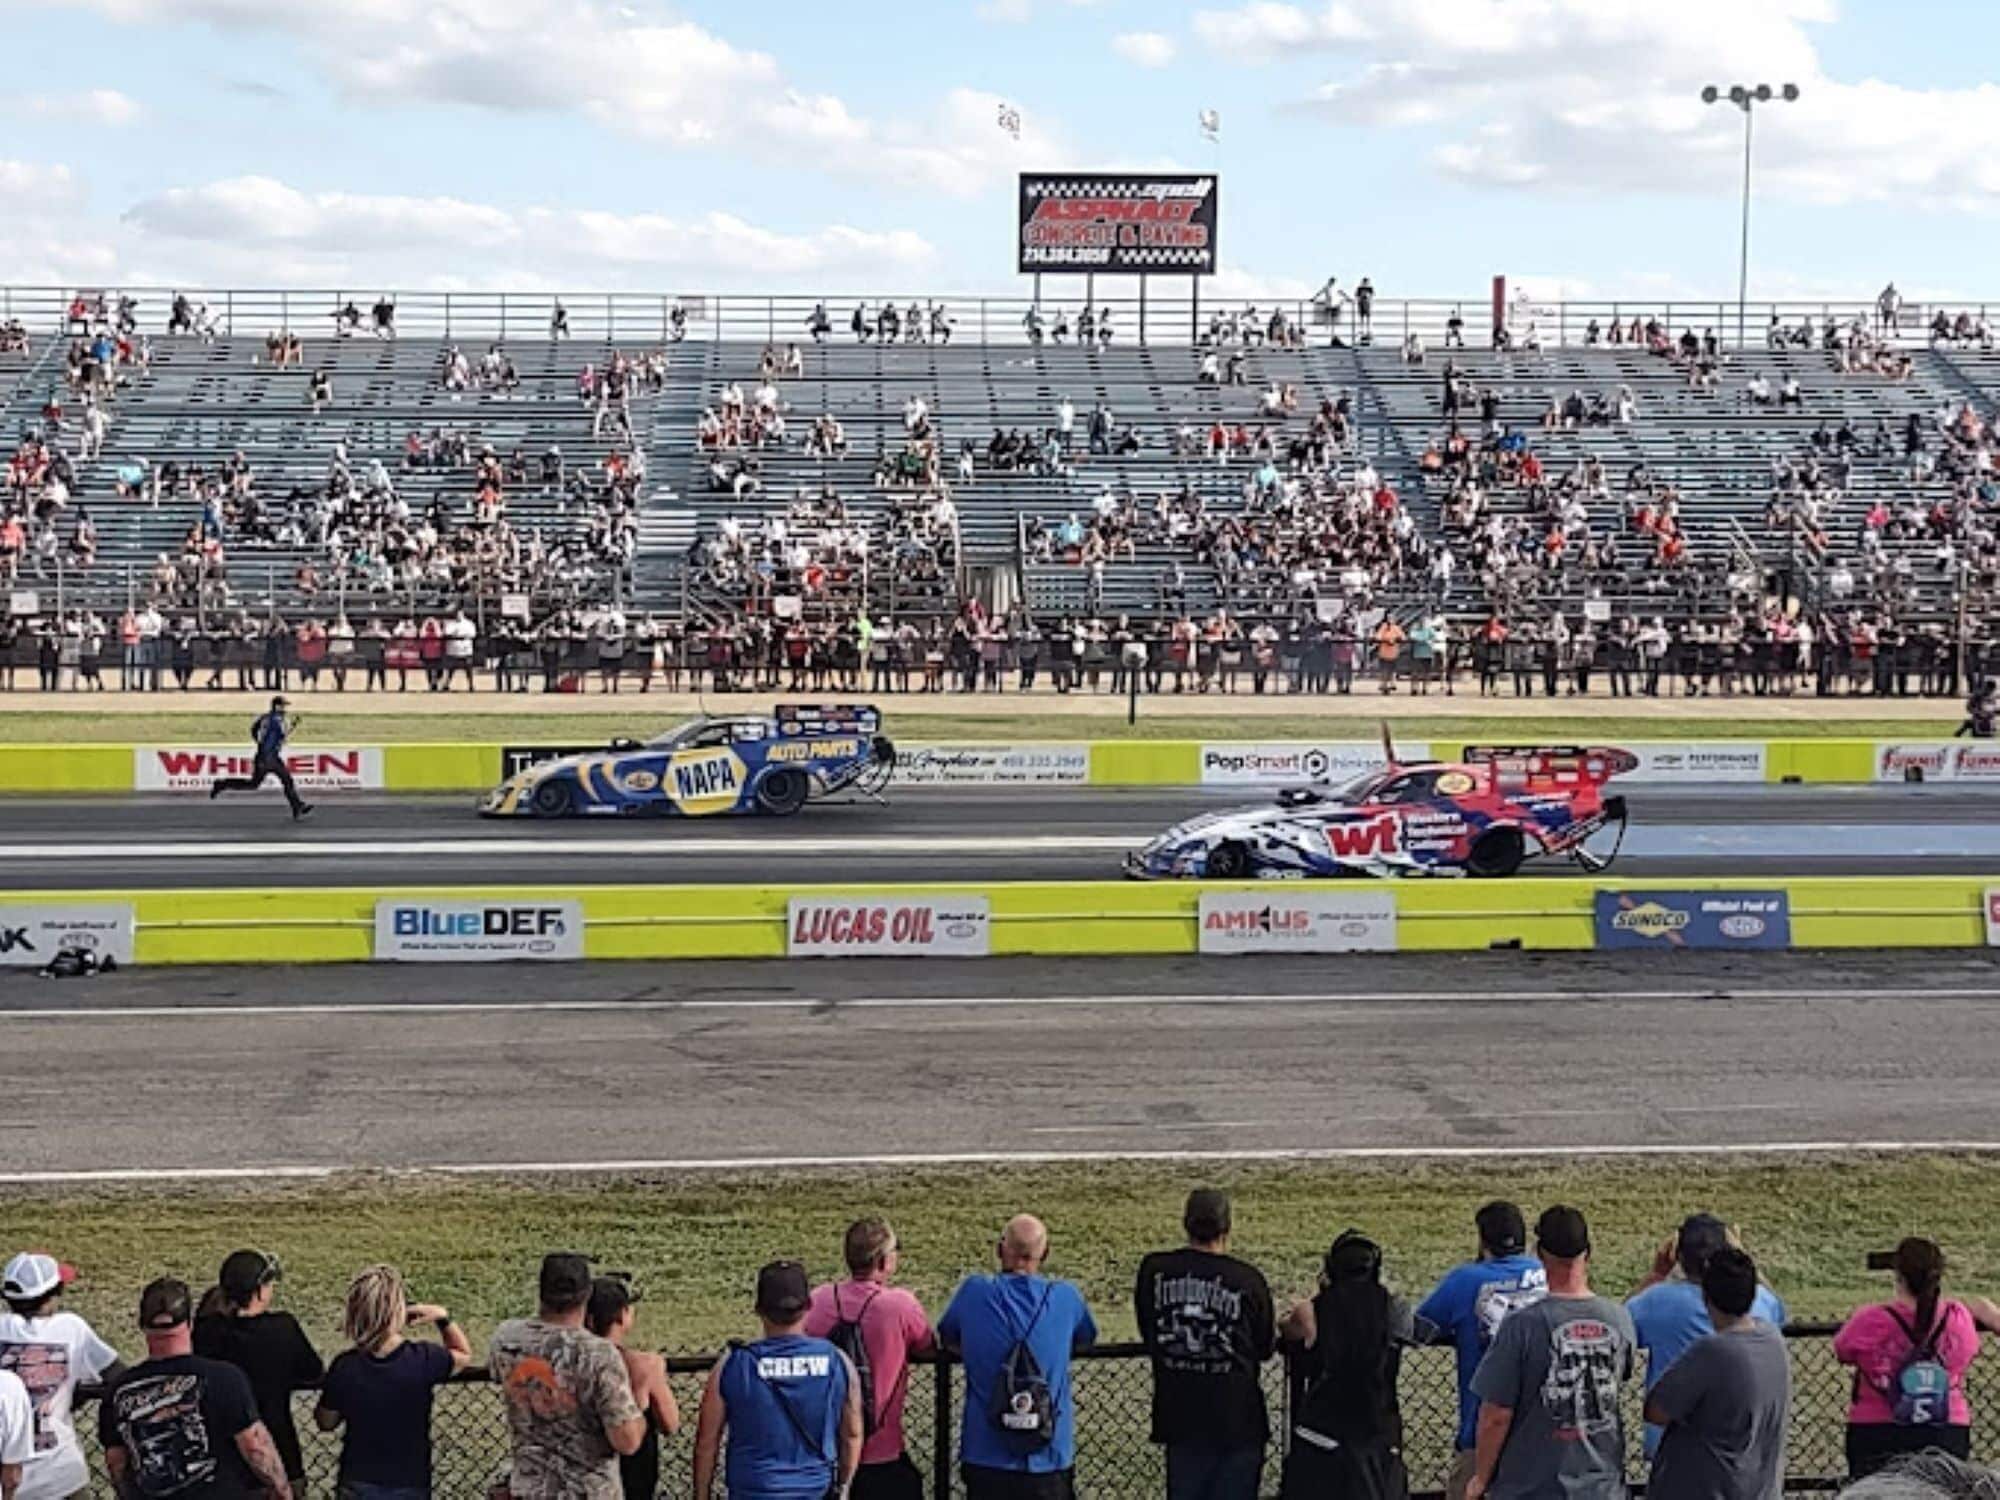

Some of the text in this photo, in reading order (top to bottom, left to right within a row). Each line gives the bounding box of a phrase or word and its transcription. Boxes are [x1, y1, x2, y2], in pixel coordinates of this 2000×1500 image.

[1032, 199, 1201, 222] ASPHALT
[1023, 224, 1208, 246] CONCRETE & PAVING
[766, 739, 859, 762] AUTO PARTS
[158, 751, 359, 776] WHEN
[674, 757, 736, 799] NAPA
[1326, 813, 1398, 857] wt
[394, 907, 563, 936] BlueDEF
[793, 907, 935, 944] LUCAS OIL
[1204, 906, 1311, 931] AMKUS
[1616, 912, 1687, 927] SUNOCO
[757, 1355, 830, 1377] CREW
